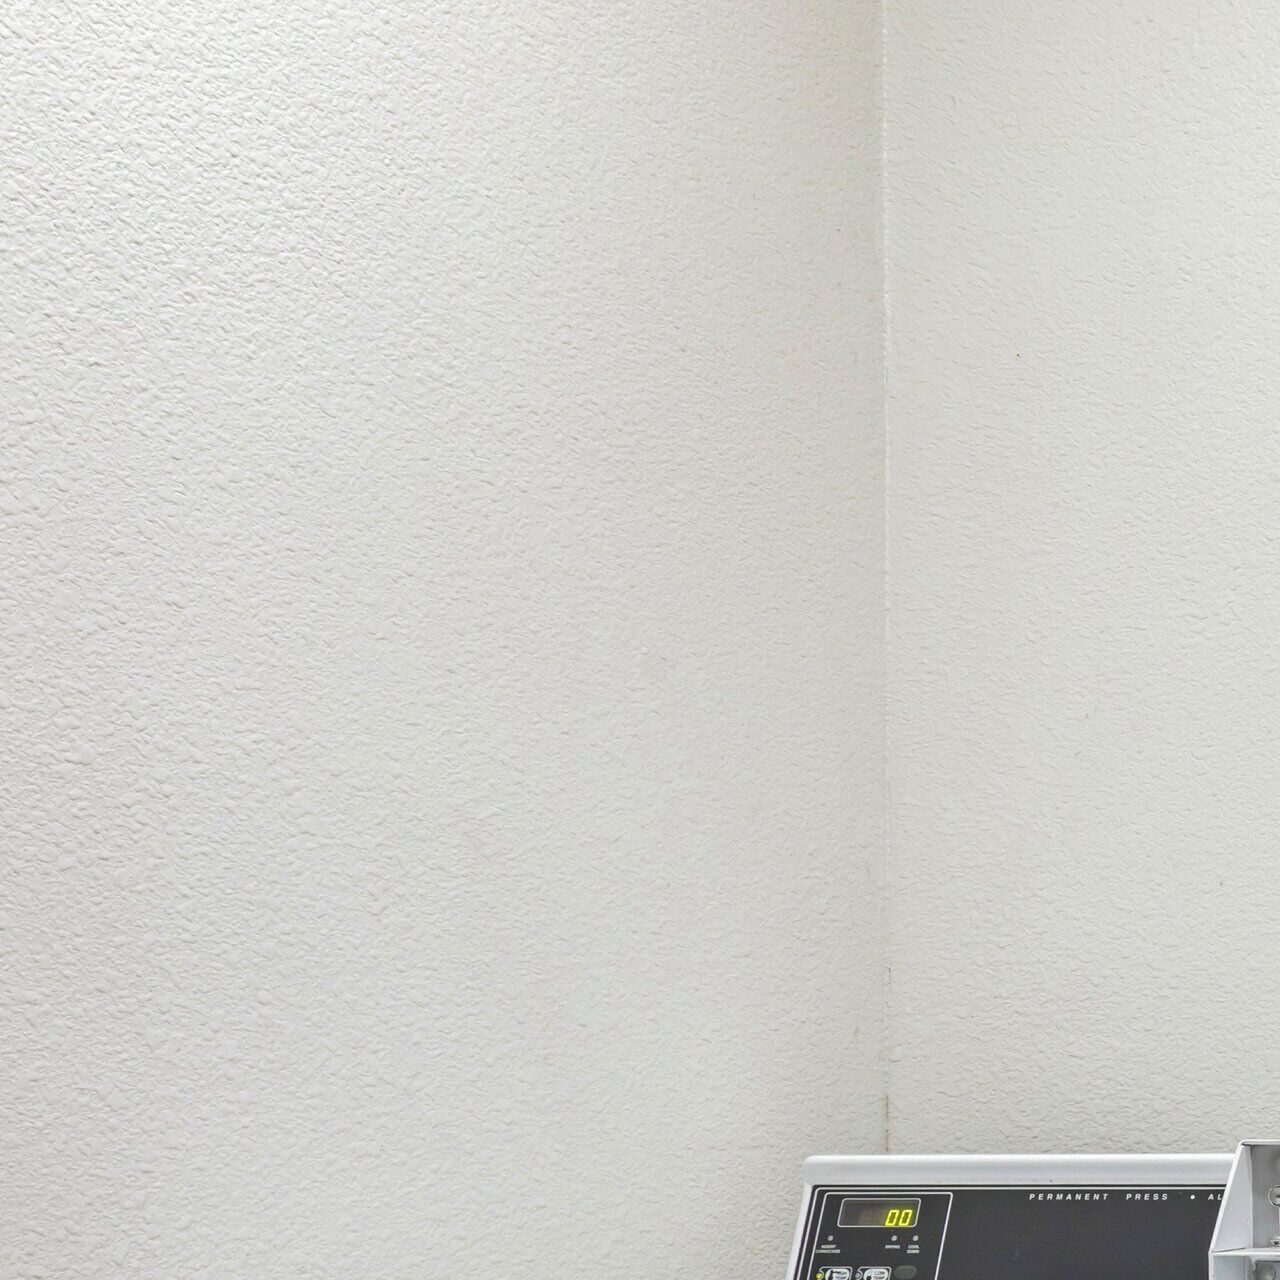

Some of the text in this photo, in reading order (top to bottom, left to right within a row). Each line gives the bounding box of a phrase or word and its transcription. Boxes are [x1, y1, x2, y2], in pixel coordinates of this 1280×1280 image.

[1029, 1193, 1109, 1201] PERMANENT
[1125, 1193, 1169, 1201] PRESS
[885, 1209, 913, 1227] 00
